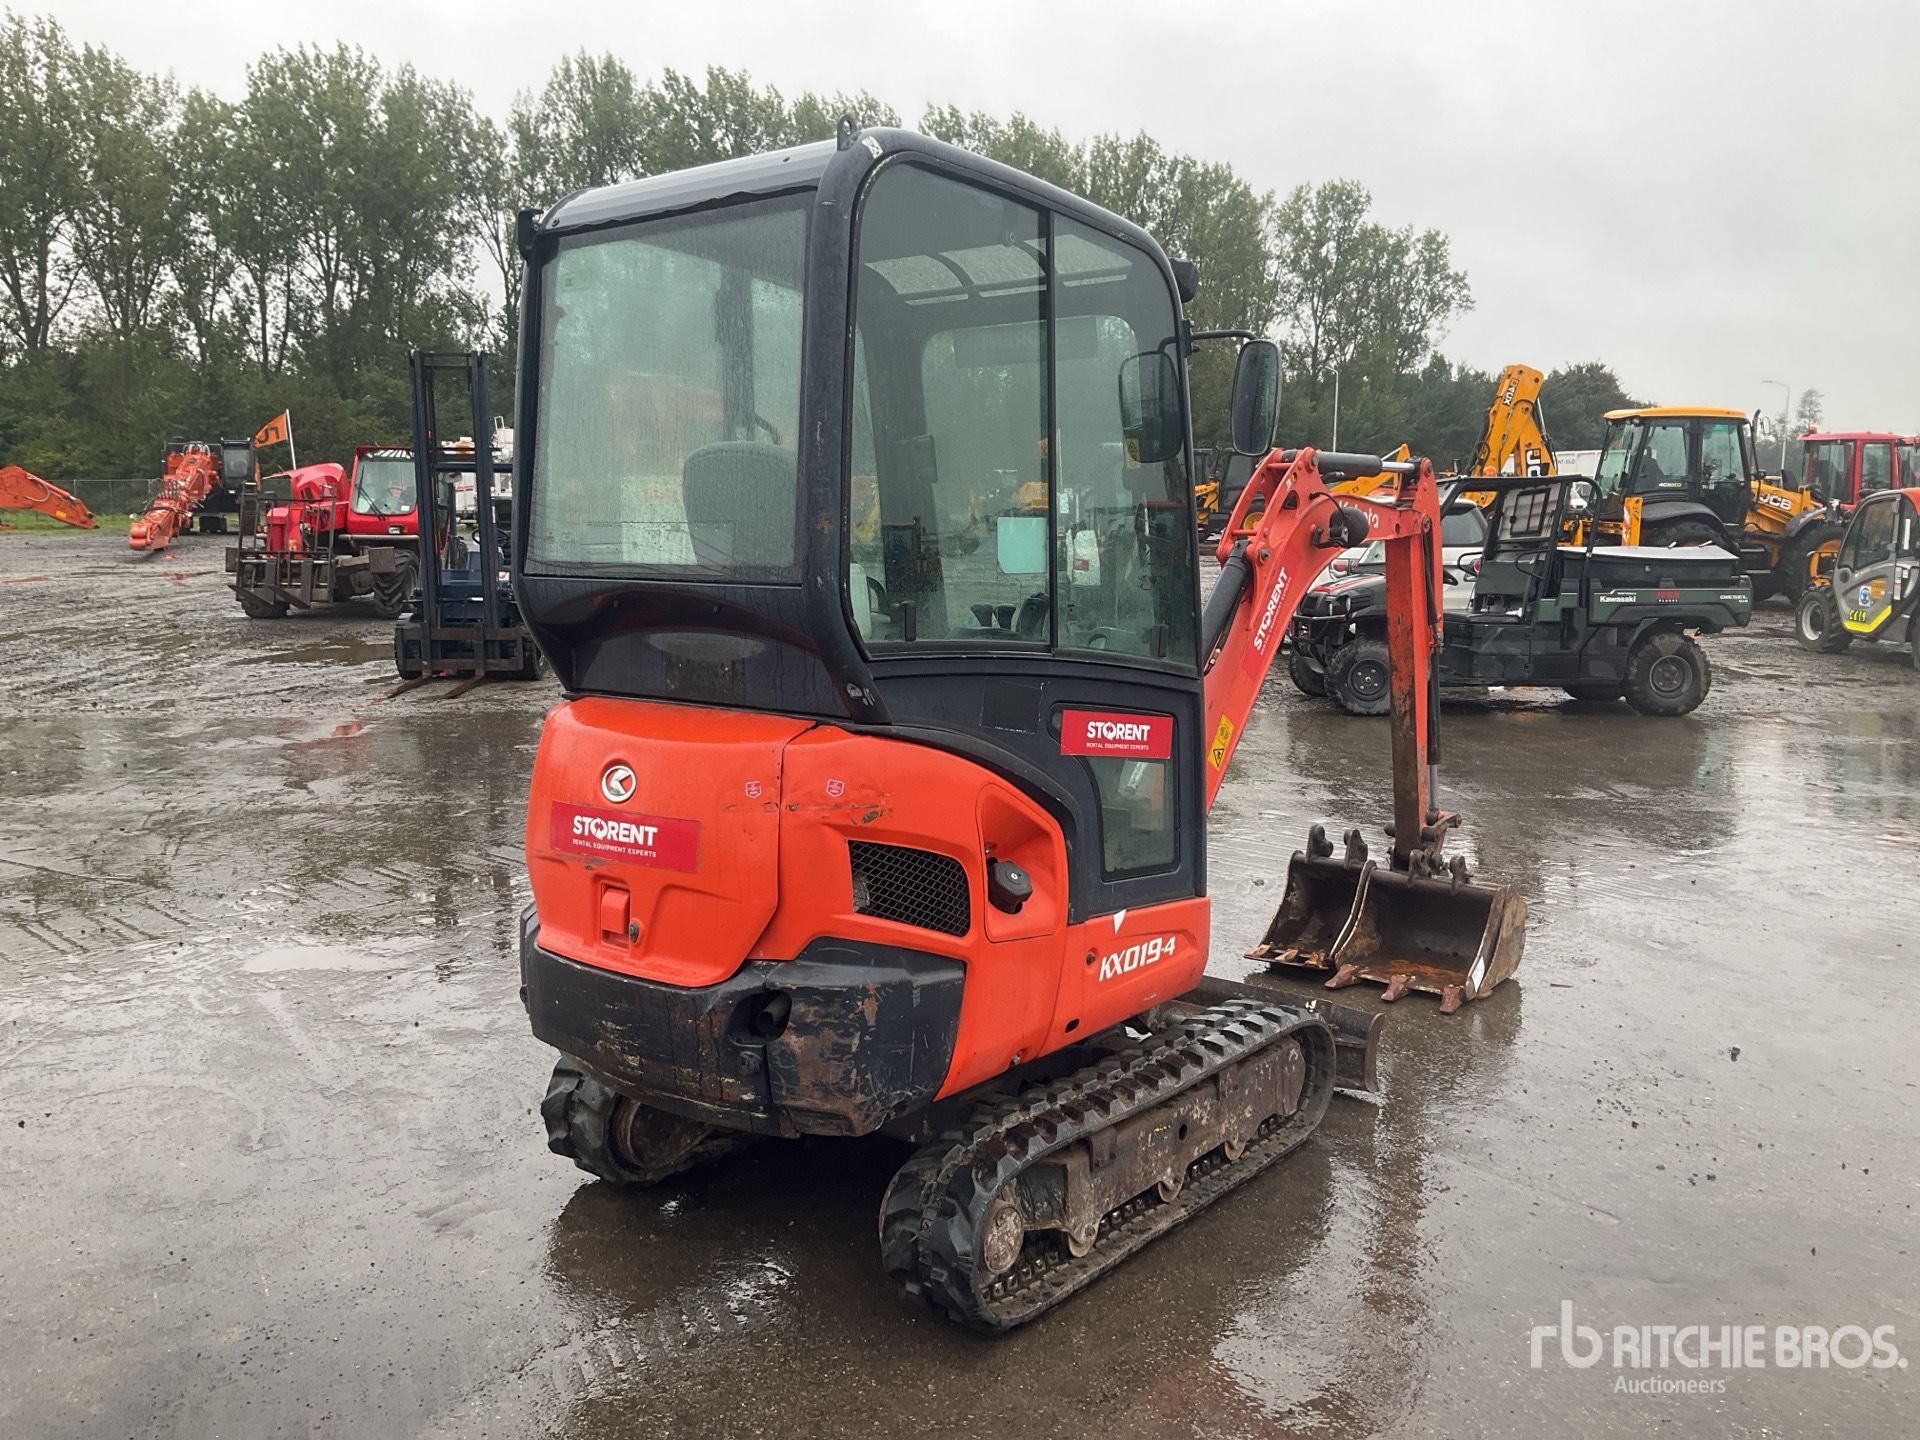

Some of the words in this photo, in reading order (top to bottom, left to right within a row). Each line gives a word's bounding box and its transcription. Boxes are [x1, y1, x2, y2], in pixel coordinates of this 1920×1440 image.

[1526, 450, 1540, 477] JC
[1759, 493, 1791, 511] JCB
[1254, 567, 1287, 650] STORENT
[1087, 721, 1151, 741] STORENT
[573, 815, 658, 846] STORENT
[572, 838, 592, 848] RENTAL
[593, 842, 626, 853] EQUIPMENT
[627, 848, 657, 858] EXPERTS
[1099, 936, 1176, 982] KX019-4
